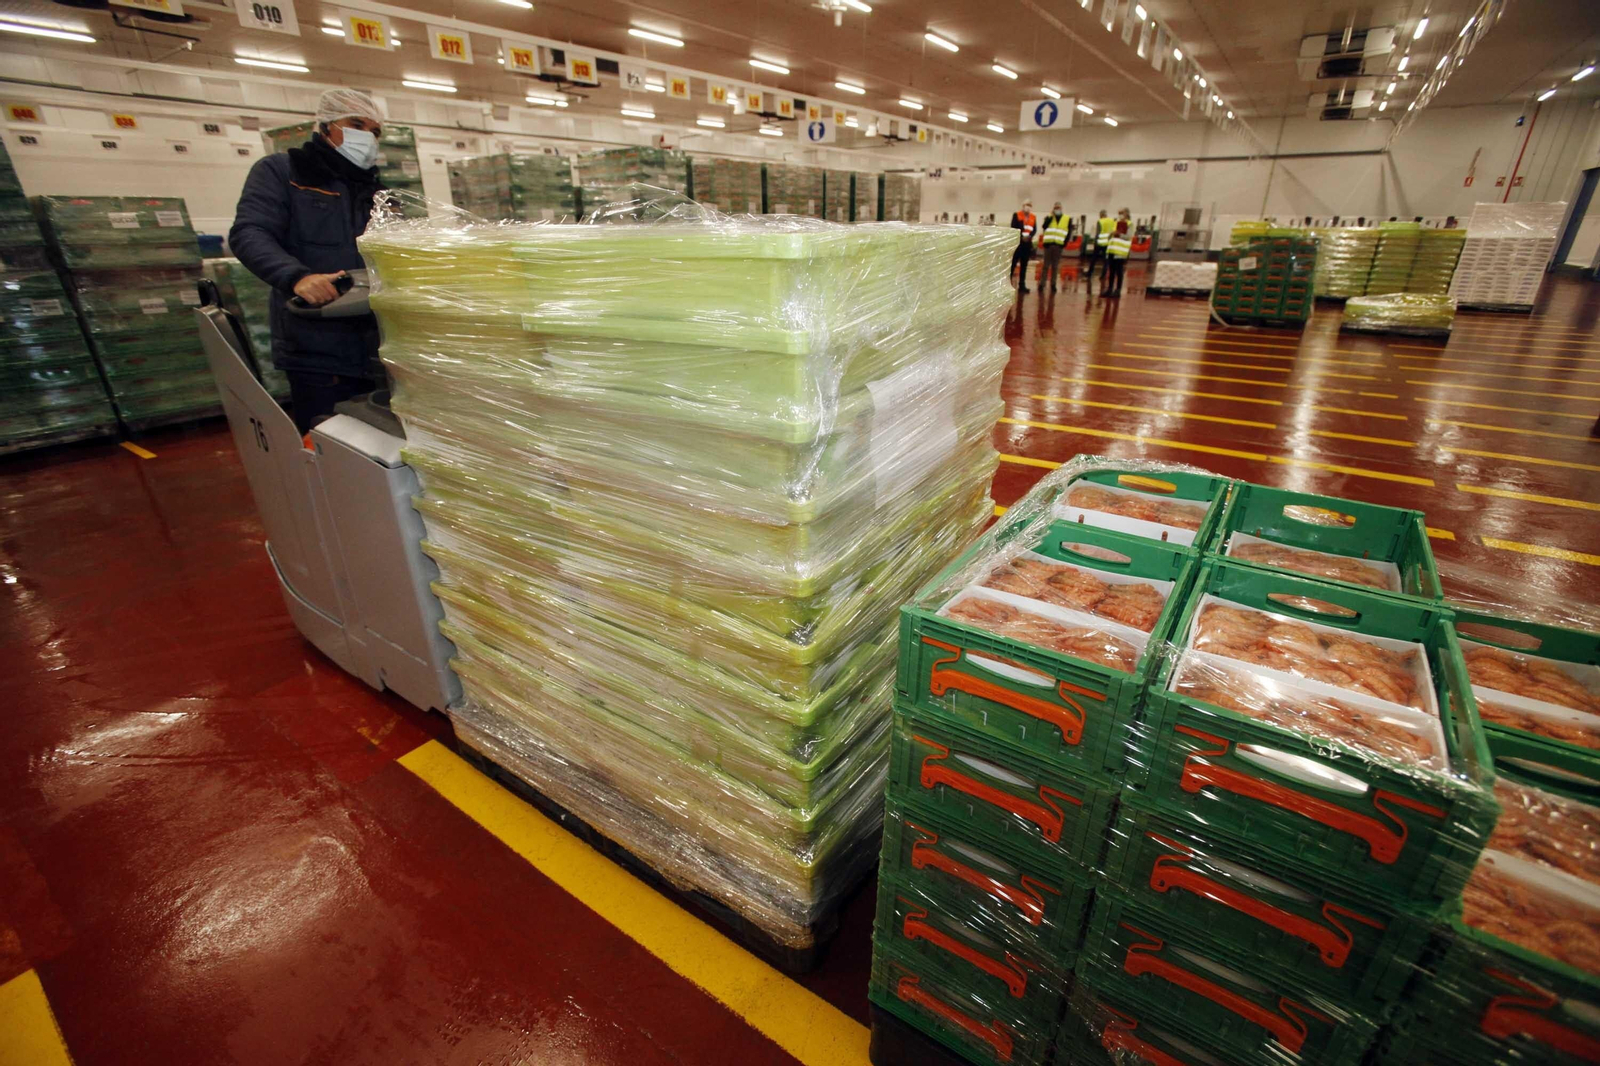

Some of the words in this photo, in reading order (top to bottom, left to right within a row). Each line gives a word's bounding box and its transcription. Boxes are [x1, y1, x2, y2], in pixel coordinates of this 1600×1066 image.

[253, 3, 282, 24] 010
[441, 38, 461, 55] 012
[249, 417, 269, 452] 76
